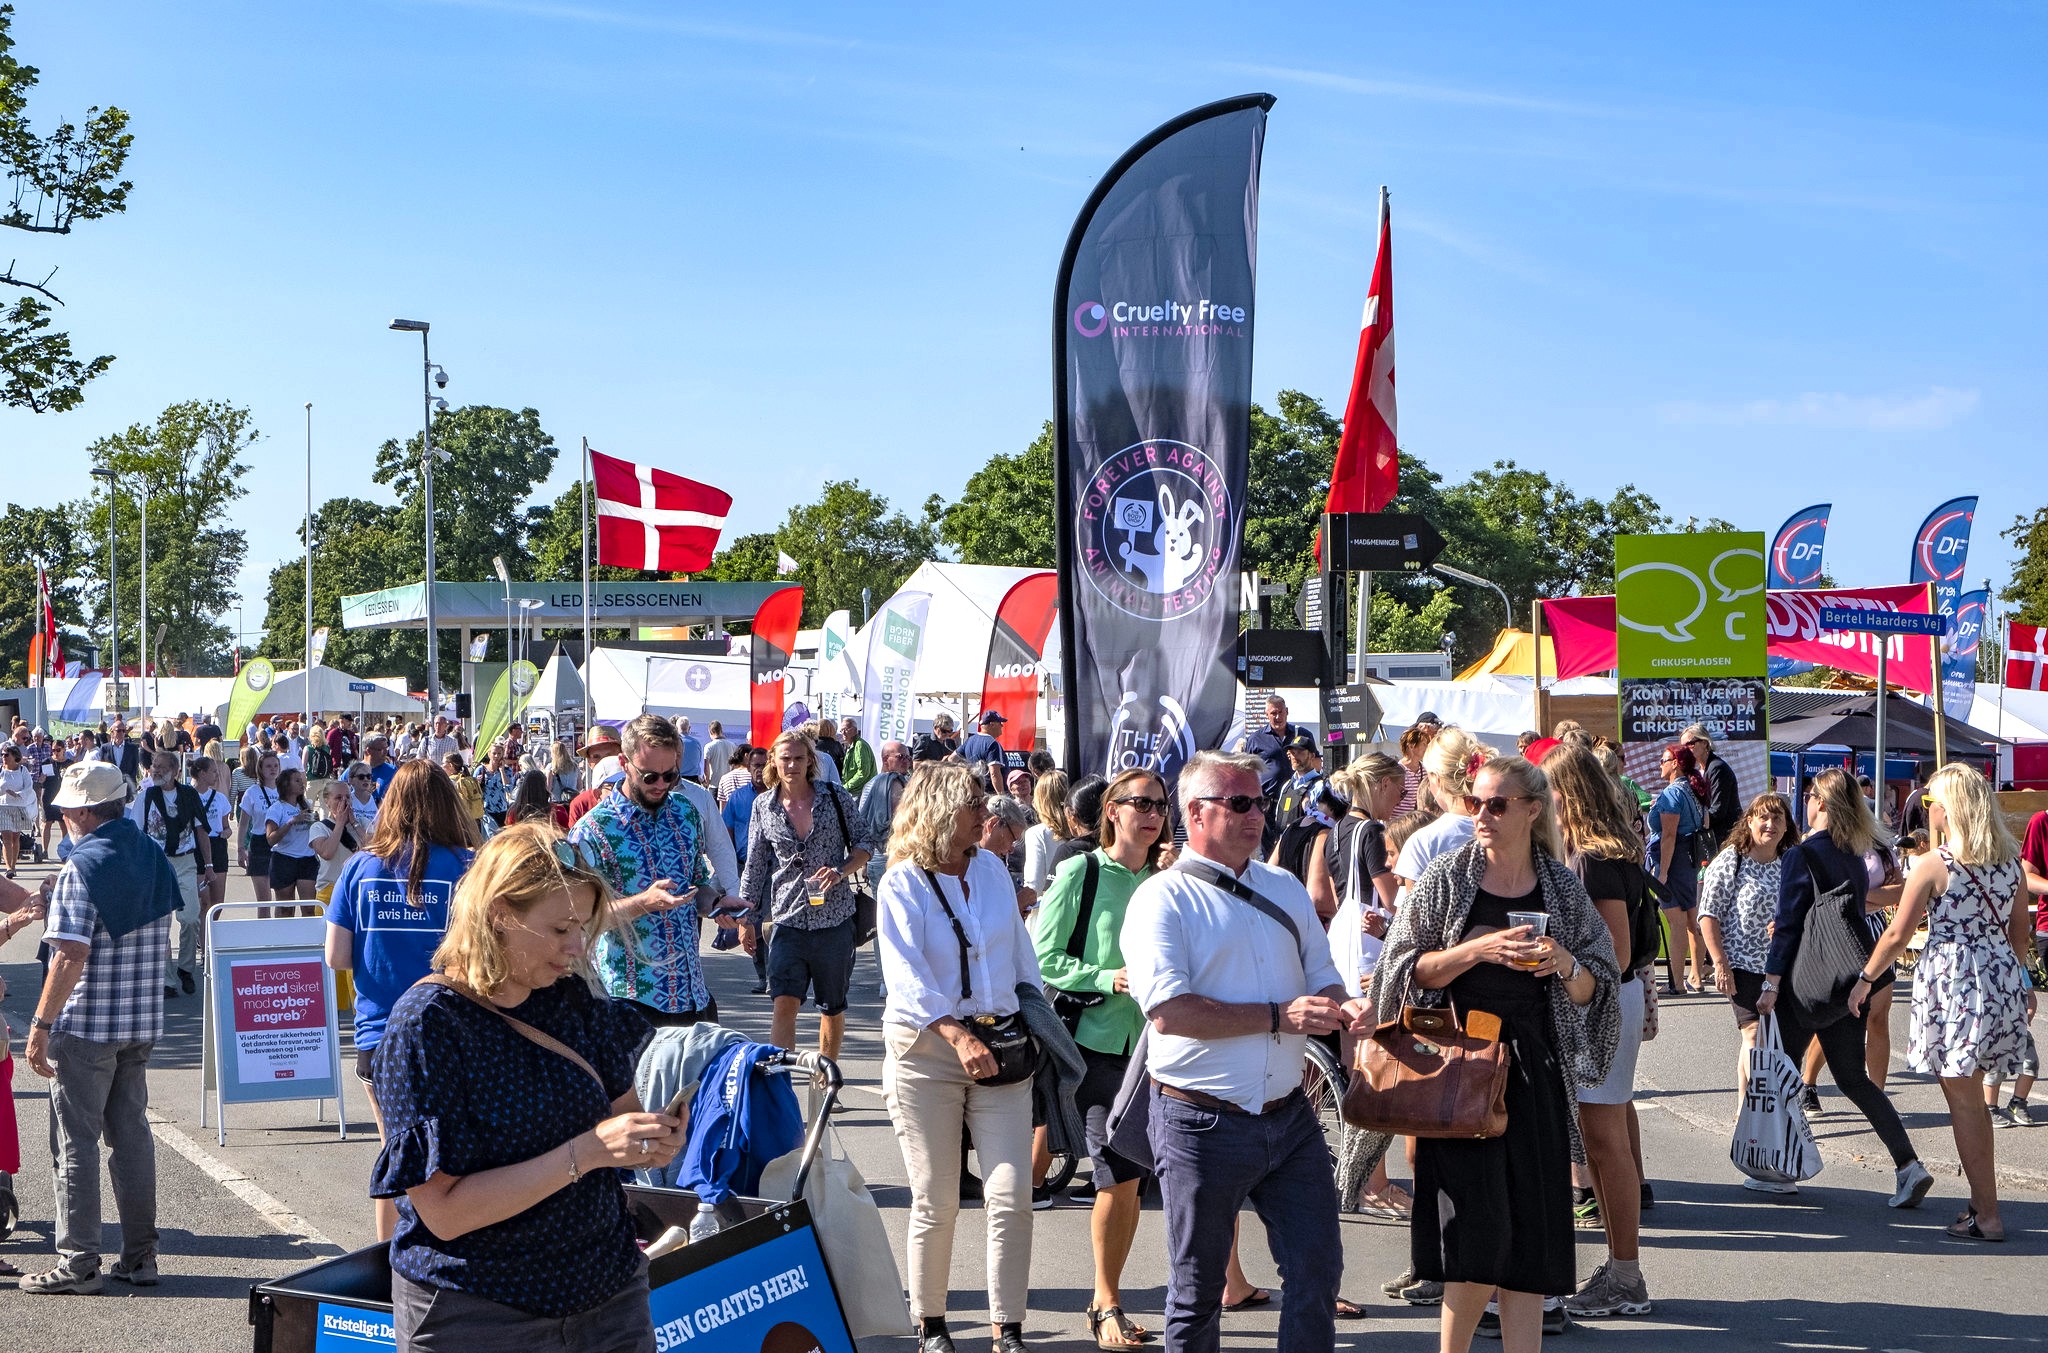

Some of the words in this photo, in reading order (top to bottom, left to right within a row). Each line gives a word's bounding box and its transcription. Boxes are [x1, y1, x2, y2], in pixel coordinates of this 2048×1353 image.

[1113, 300, 1192, 325] Cruelty
[1199, 300, 1245, 323] Free
[1113, 325, 1244, 337] INTERNATIONAL
[1084, 447, 1156, 521] FOREVER
[1167, 448, 1227, 520] AGAINST
[1353, 538, 1399, 547] MAD&MENINGER
[1937, 536, 1969, 556] DF
[1791, 542, 1822, 560] DF
[1086, 548, 1150, 612] ANIMAL
[1162, 546, 1221, 612] TESTING
[1725, 611, 1746, 641] C
[1825, 611, 1862, 624] Bertel
[1867, 614, 1918, 628] Haarders
[1922, 617, 1941, 631] Vej
[890, 625, 915, 637] BORN
[1959, 621, 1979, 637] DF
[889, 634, 913, 646] FIBER
[1248, 654, 1293, 662] UNGDOMSCAMP
[1651, 657, 1731, 667] CIRKUSPLADSEN
[1632, 688, 1663, 700] KOM
[1673, 688, 1695, 700] TIL
[1701, 687, 1755, 700] KÆMPE
[879, 666, 895, 741] BREDBÅND
[1632, 704, 1733, 717] MORGENBORD
[1736, 701, 1756, 716] PÅ
[1632, 719, 1756, 733] CIRKUSADSEN
[1121, 729, 1162, 750] THE
[368, 890, 380, 903] Få
[383, 891, 401, 903] din
[378, 908, 400, 921] avis
[403, 907, 426, 921] her.
[254, 970, 269, 982] Er
[270, 970, 301, 981] vores
[236, 982, 288, 996] velfærd
[289, 981, 320, 993] sikret
[243, 999, 271, 1009] mod
[272, 996, 315, 1011] cyber-
[253, 1008, 307, 1024] angreb?
[253, 1039, 278, 1047] danske
[278, 1038, 304, 1046] forsvar,
[280, 1031, 321, 1039] sikkerheden
[296, 1044, 320, 1052] energi-
[694, 1285, 764, 1333] GRATIS
[761, 1265, 809, 1304] HER!
[324, 1314, 380, 1338] Kristeligt
